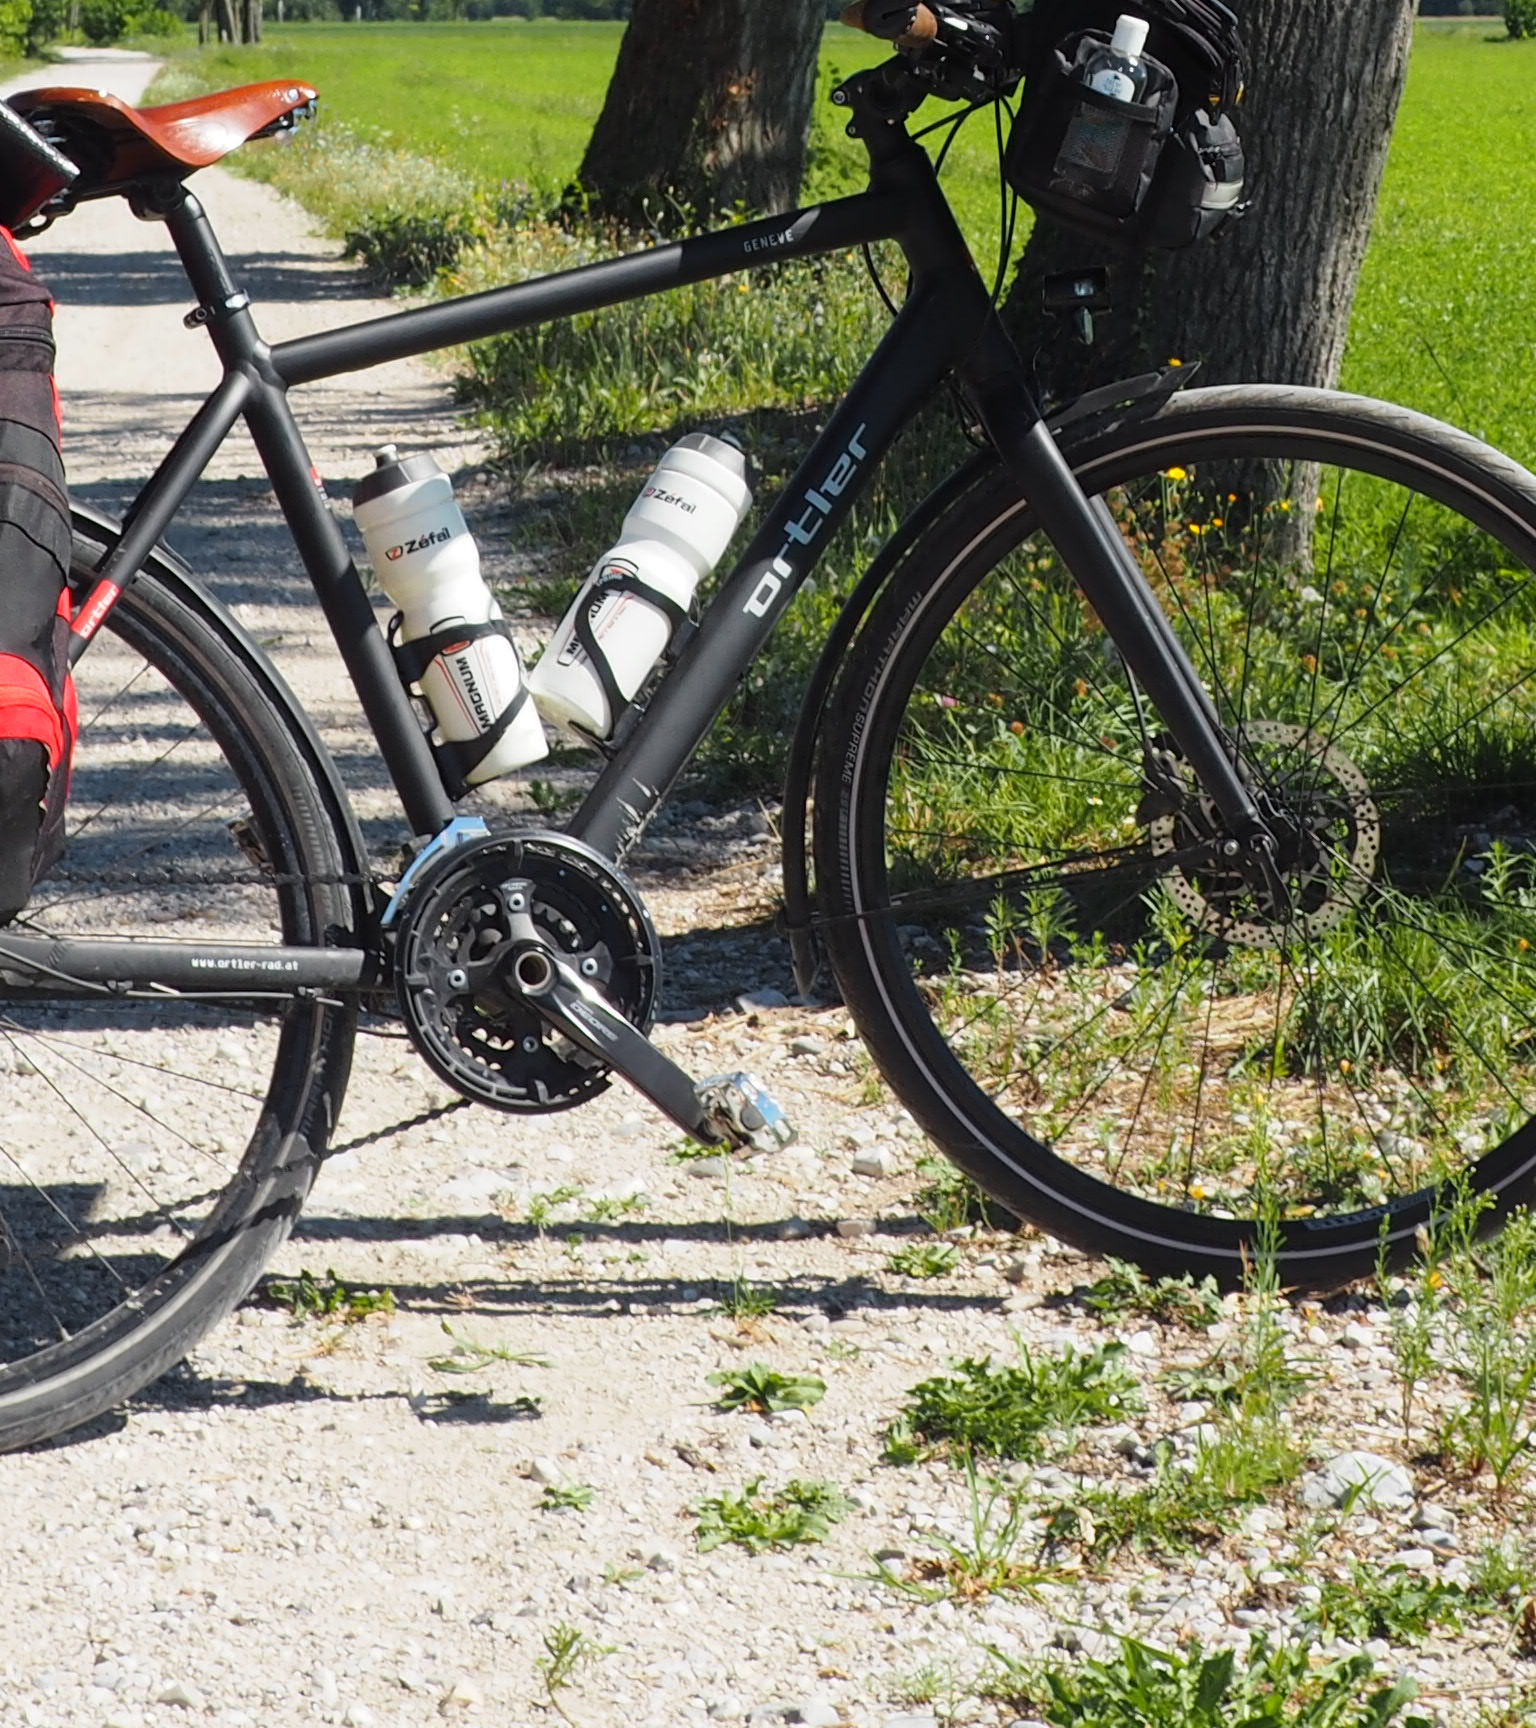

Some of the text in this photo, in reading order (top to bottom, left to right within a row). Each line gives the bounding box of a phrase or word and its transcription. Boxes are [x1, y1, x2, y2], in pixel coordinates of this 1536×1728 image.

[744, 229, 794, 252] GENEVE
[742, 422, 871, 622] ortler
[455, 656, 491, 729] MAGNUM
[841, 712, 865, 784] SUPREME
[191, 957, 299, 971] www.ortler-rad.at
